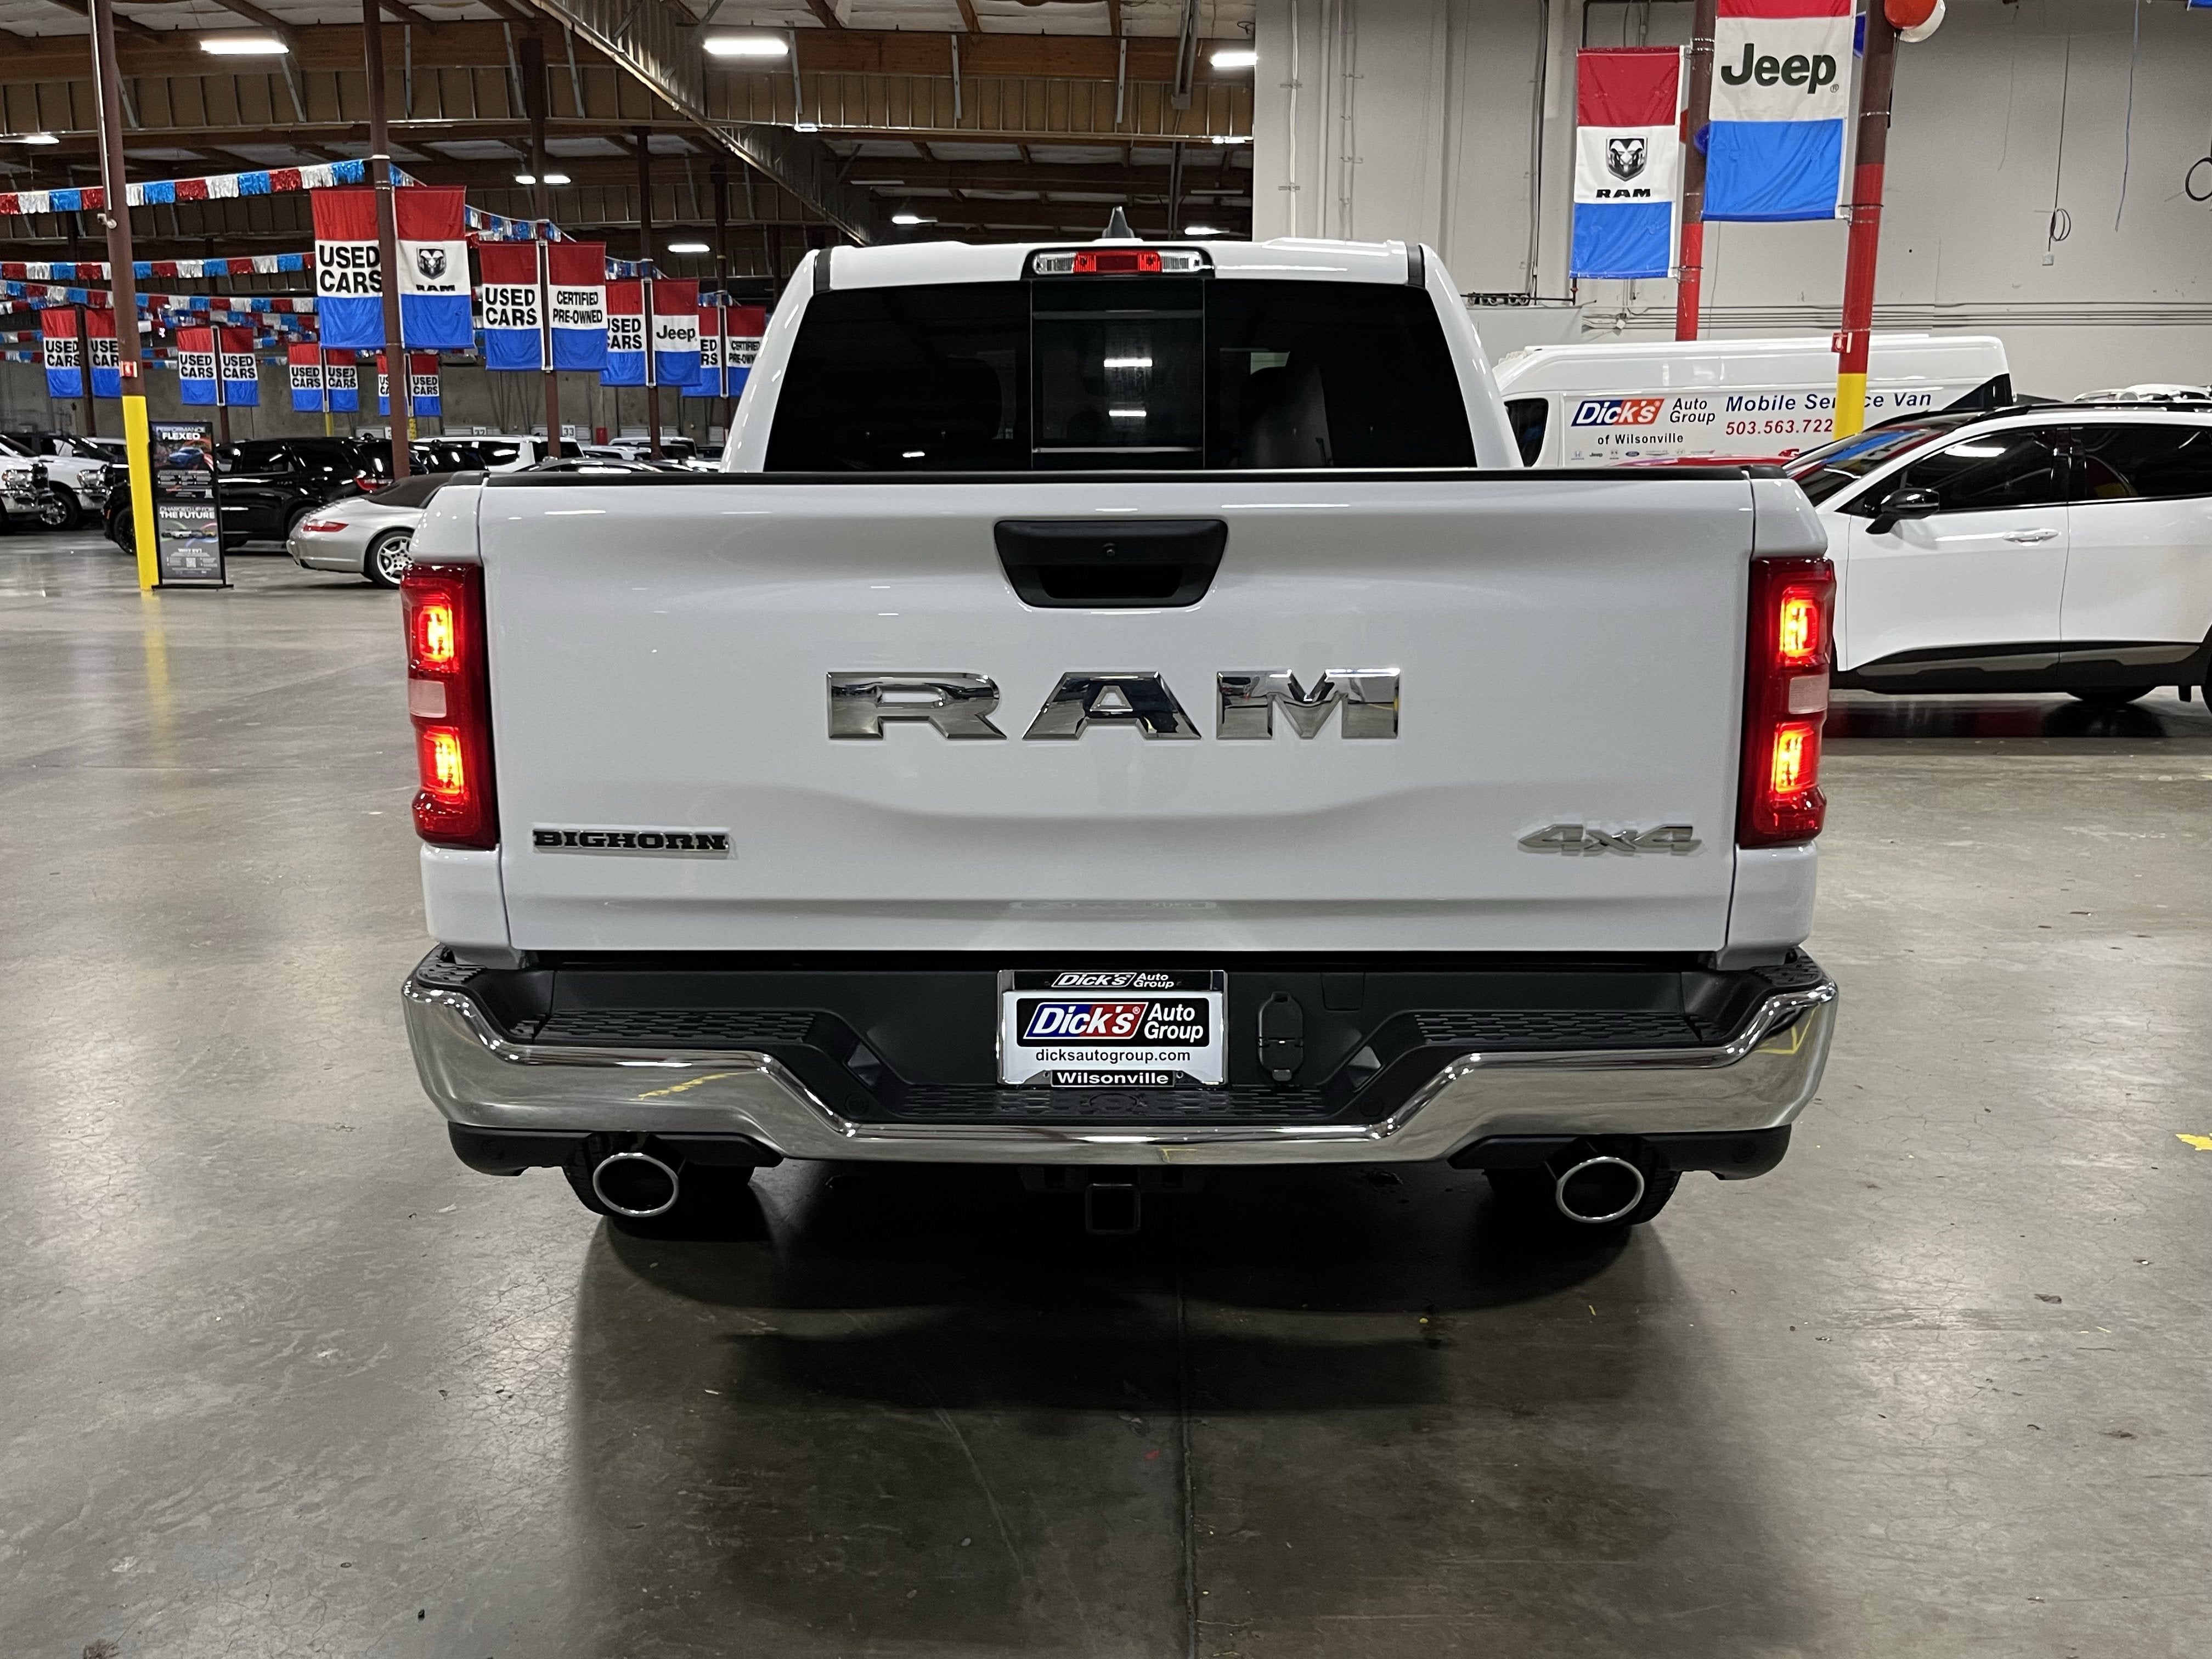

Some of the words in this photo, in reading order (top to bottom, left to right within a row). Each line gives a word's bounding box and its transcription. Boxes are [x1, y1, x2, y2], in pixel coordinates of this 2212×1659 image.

[1720, 43, 1837, 94] Jeep
[1596, 188, 1651, 198] RAM
[319, 245, 380, 268] USED
[320, 270, 381, 293] CARS
[486, 287, 535, 306] USED
[557, 291, 598, 305] CERTIFIED
[486, 307, 537, 326] CARS
[553, 308, 603, 324] PRE-OWNED
[607, 318, 641, 332] SED
[656, 325, 696, 342] Jeep
[46, 341, 78, 353] USED
[91, 341, 119, 353] USE
[607, 334, 642, 349] ARS
[700, 339, 717, 351] ED
[47, 354, 81, 366] CARS
[93, 354, 119, 366] CAR
[180, 354, 212, 366] USED
[223, 356, 254, 367] USED
[701, 353, 718, 365] RS
[181, 366, 213, 378] CARS
[223, 368, 256, 379] CARS
[291, 367, 320, 377] USED
[328, 367, 356, 377] USED
[292, 377, 321, 388] CARS
[329, 377, 356, 388] CARS
[413, 376, 437, 385] USED
[414, 386, 438, 394] CARS
[1725, 394, 1796, 411] Mobile
[1894, 392, 1932, 407] Van
[1576, 400, 1656, 425] Dick's
[1672, 398, 1707, 410] Auto
[1669, 410, 1716, 426] Group
[563, 427, 574, 436] 33
[1725, 419, 1833, 435] 503.563.722
[162, 432, 201, 441] FLEXED
[1598, 434, 1610, 445] of
[1615, 432, 1684, 444] Wilsonville
[179, 511, 215, 520] FUTURE
[826, 668, 1401, 740] RAM
[533, 830, 727, 850] BIGHORN
[1058, 974, 1127, 985] Dick's
[1137, 973, 1169, 981] Auto
[1133, 980, 1175, 989] Group
[1032, 1006, 1135, 1035] Dick's
[1147, 1003, 1195, 1022] Auto
[1144, 1021, 1204, 1043] Group
[1036, 1048, 1190, 1064] dicksautogroup.com
[1057, 1071, 1169, 1084] Wilsonville
